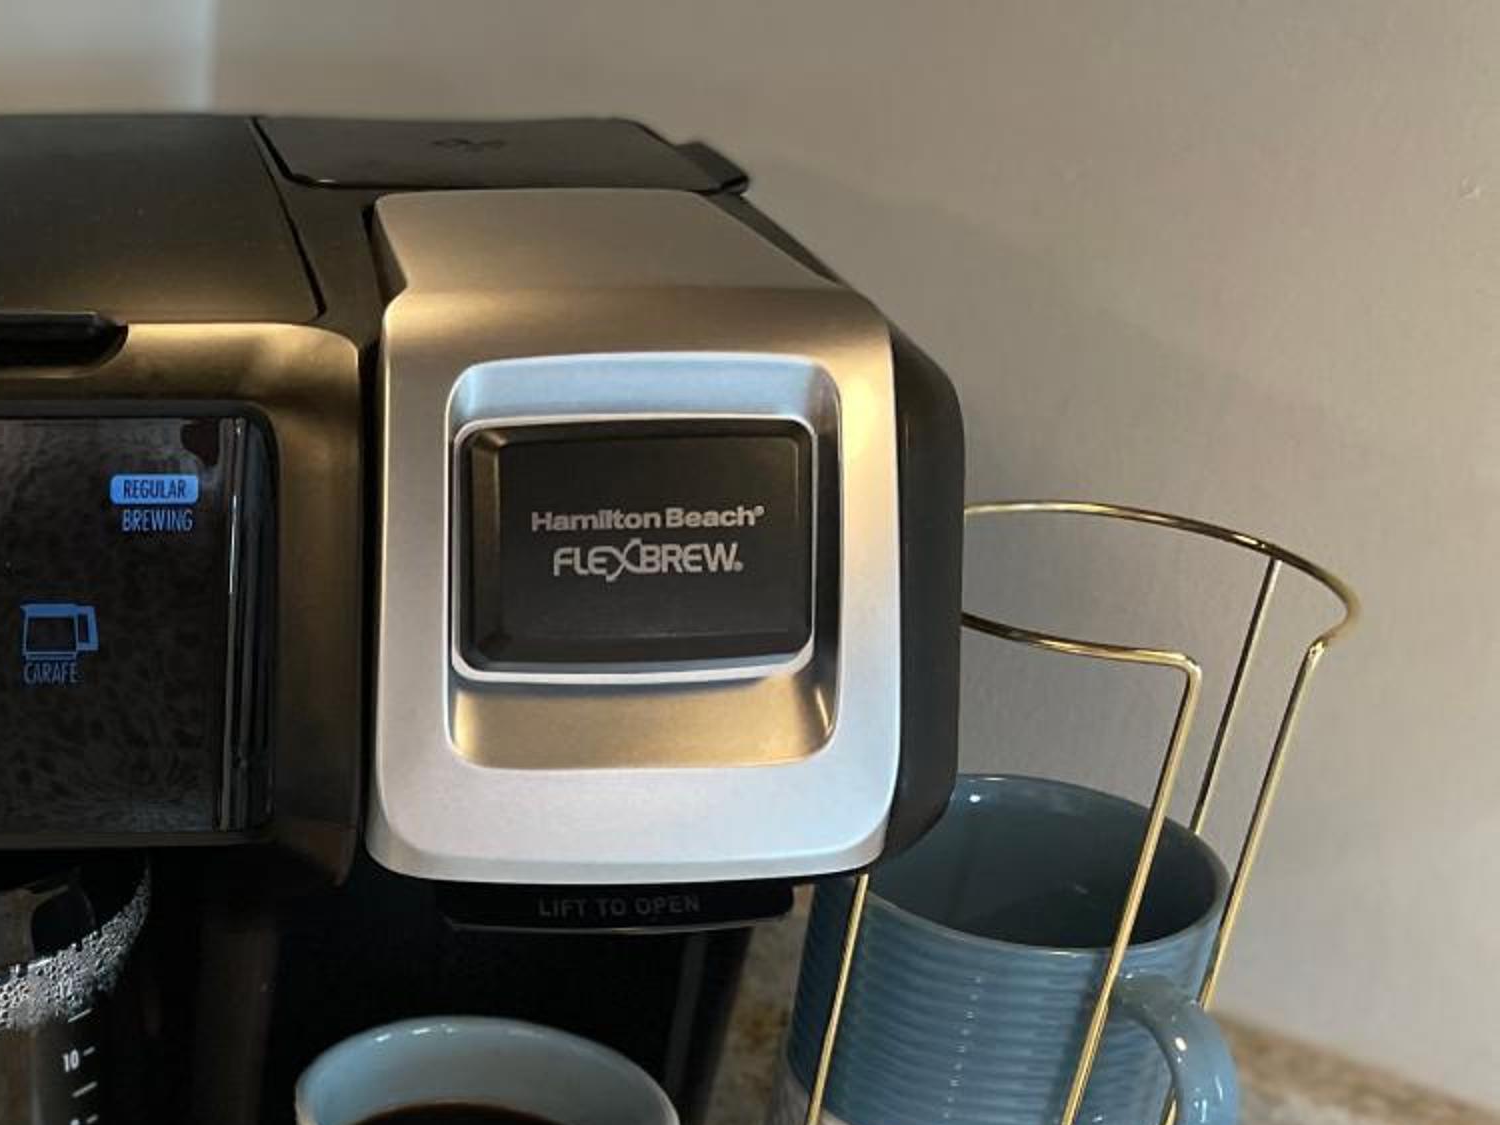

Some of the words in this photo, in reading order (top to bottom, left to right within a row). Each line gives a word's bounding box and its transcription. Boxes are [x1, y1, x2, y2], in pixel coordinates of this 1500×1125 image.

[123, 479, 187, 499] REGULAR
[122, 508, 193, 532] BREWING
[531, 508, 662, 532] Hamilton
[23, 661, 79, 684] CARAFE
[538, 896, 586, 919] LIFT
[597, 896, 627, 917] TO
[634, 893, 701, 915] OPEN
[62, 1049, 80, 1073] 10
